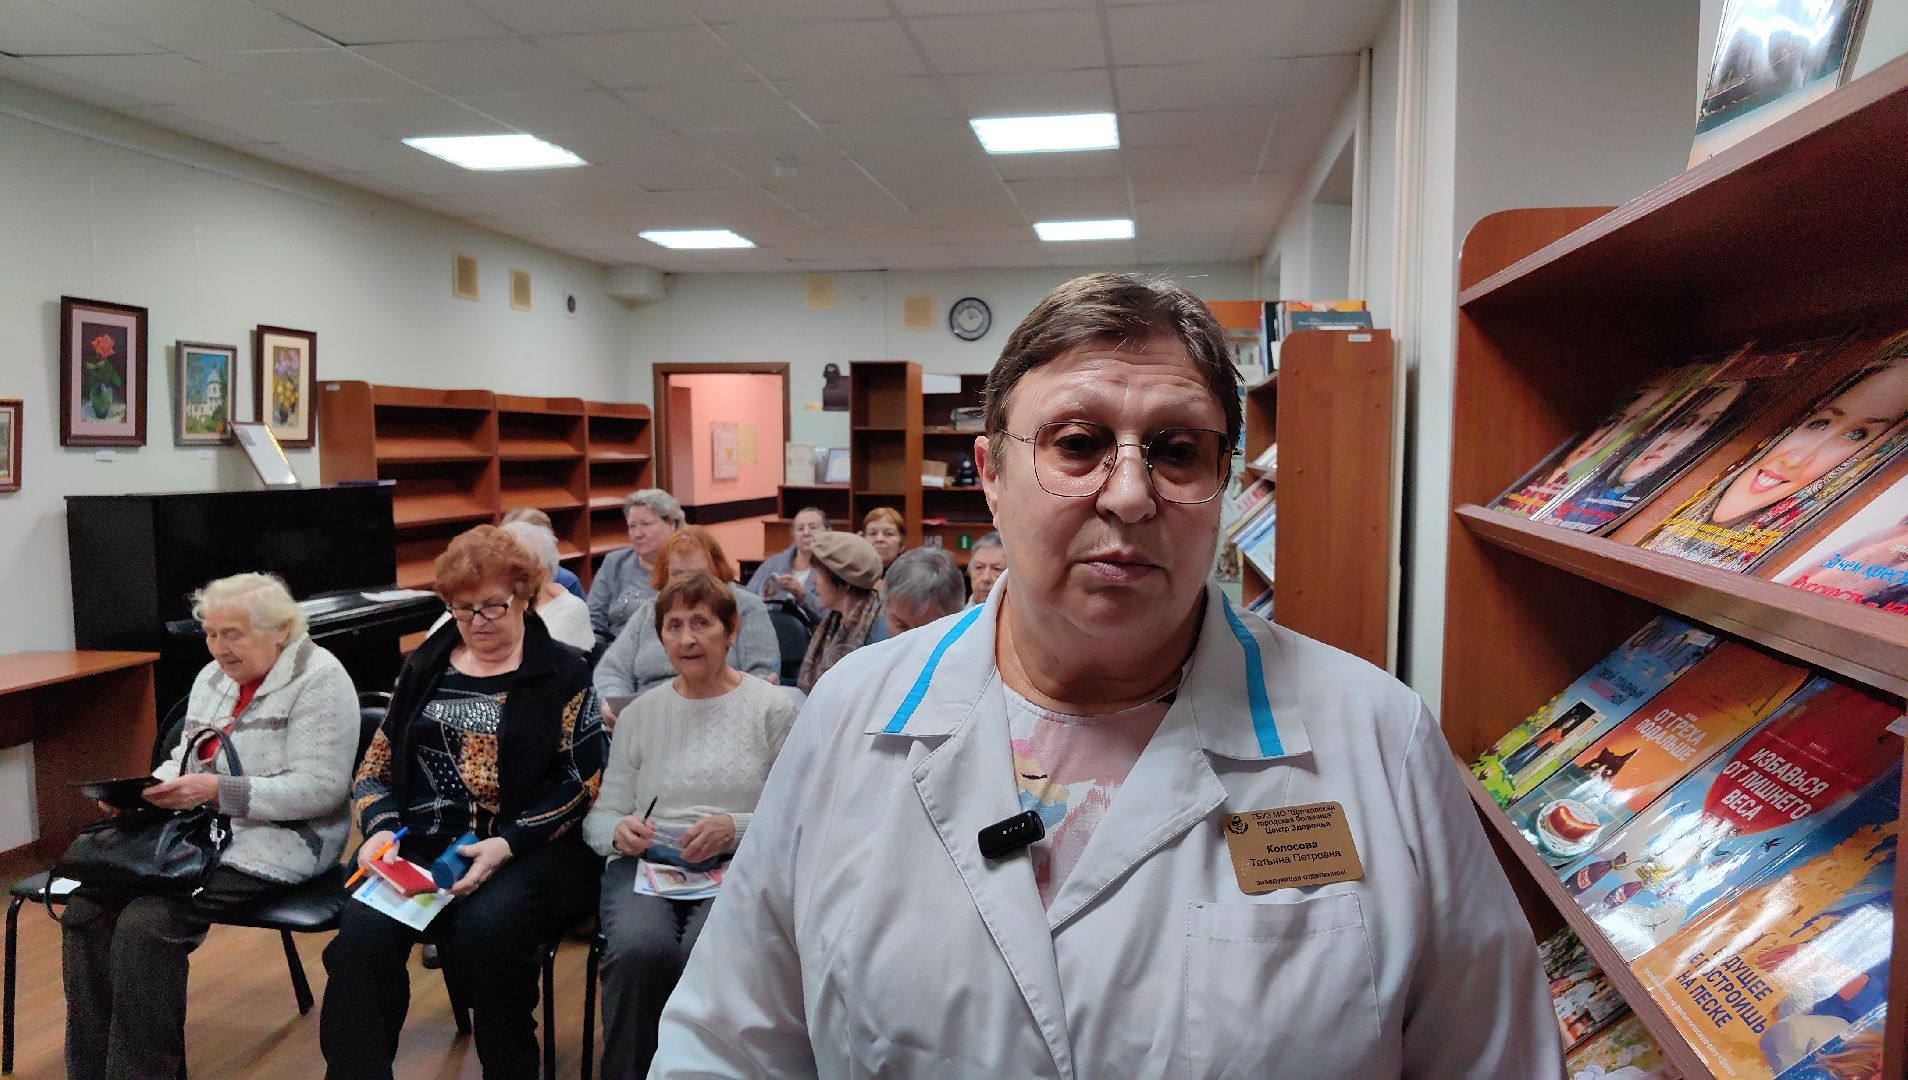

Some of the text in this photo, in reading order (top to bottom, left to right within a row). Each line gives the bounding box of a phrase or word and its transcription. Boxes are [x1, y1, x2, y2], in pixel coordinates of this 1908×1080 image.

[1634, 719, 1697, 762] ПОДАЛЬШЕ
[1654, 709, 1677, 725] ОТ
[1666, 716, 1707, 746] ГРЕХА
[1722, 760, 1813, 820] ОТ ЛИШНЕГО
[1748, 747, 1830, 799] ИЗБАВЬСЯ
[1720, 788, 1774, 821] ВЕСА
[1265, 826, 1290, 835] Центр
[1249, 850, 1342, 867] Татьяна Петровна
[1713, 944, 1774, 1002] ДУЩЕЕ
[1675, 970, 1734, 1029] НА ПЕСКЕ
